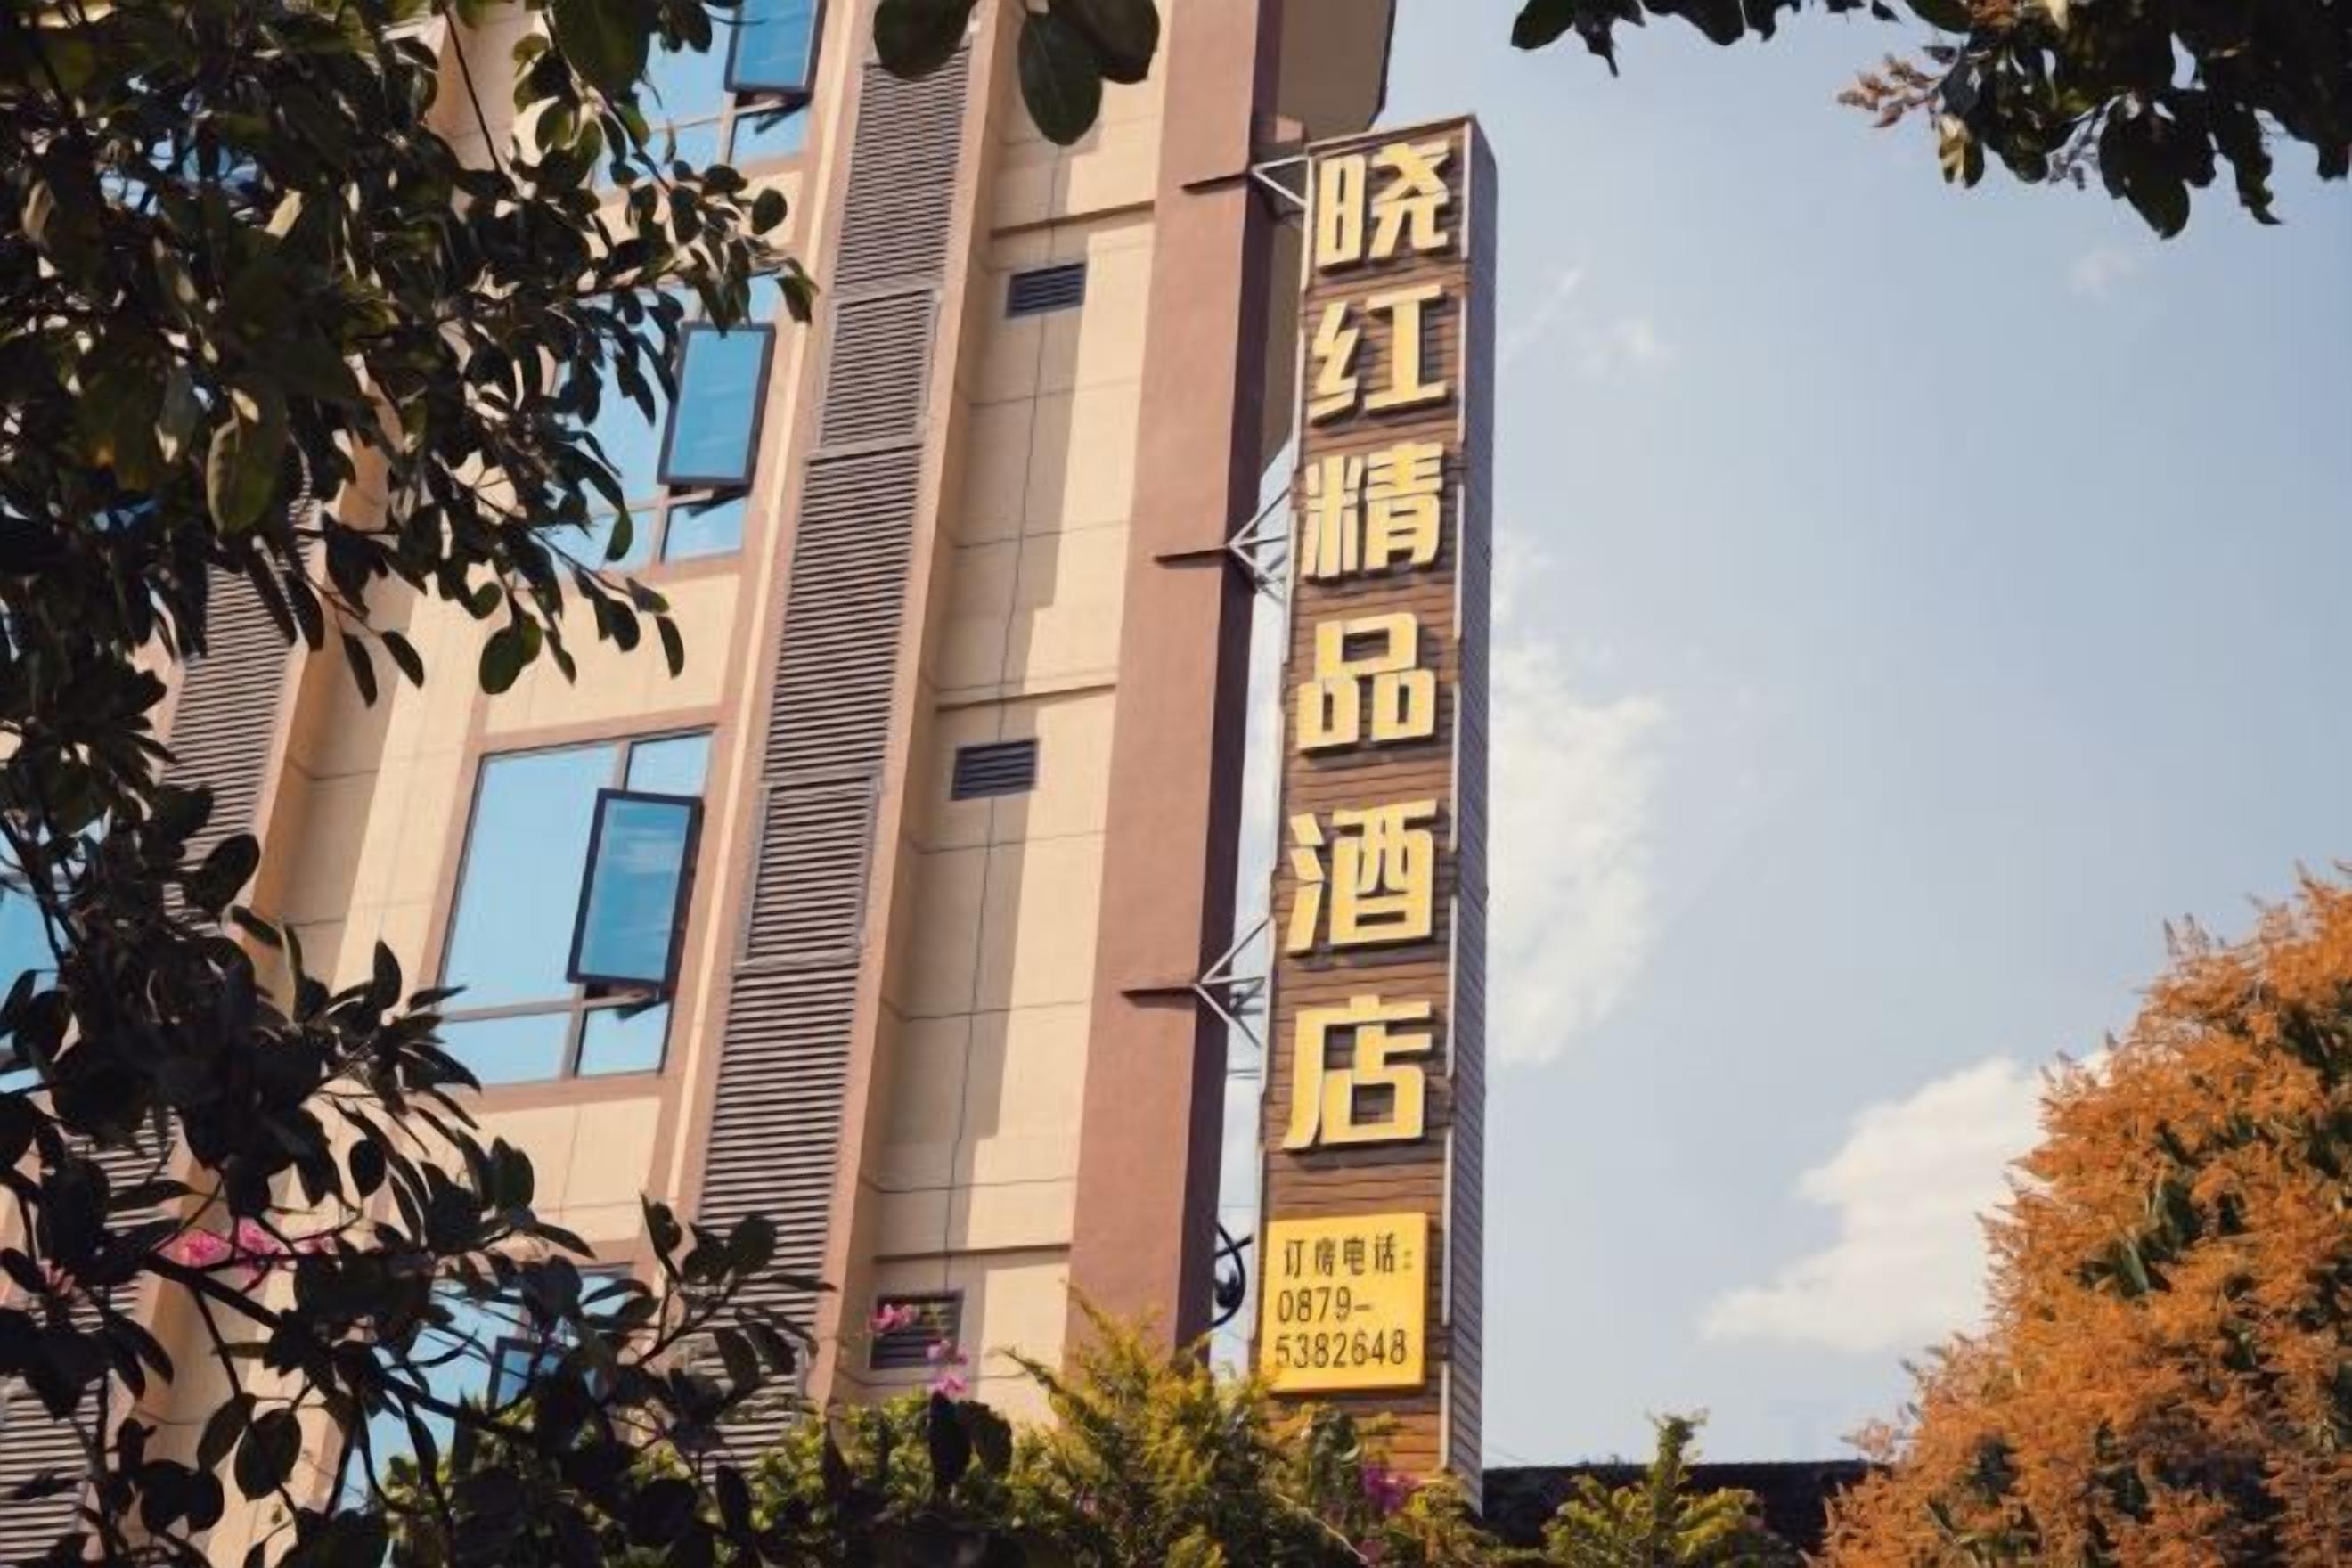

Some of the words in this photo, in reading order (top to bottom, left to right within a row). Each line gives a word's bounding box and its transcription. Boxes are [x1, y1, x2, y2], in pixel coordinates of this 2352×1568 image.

[1283, 141, 1450, 1149] 晓红精品酒店
[1277, 1286, 1372, 1322] 0879-
[1275, 1329, 1406, 1368] 5382648
